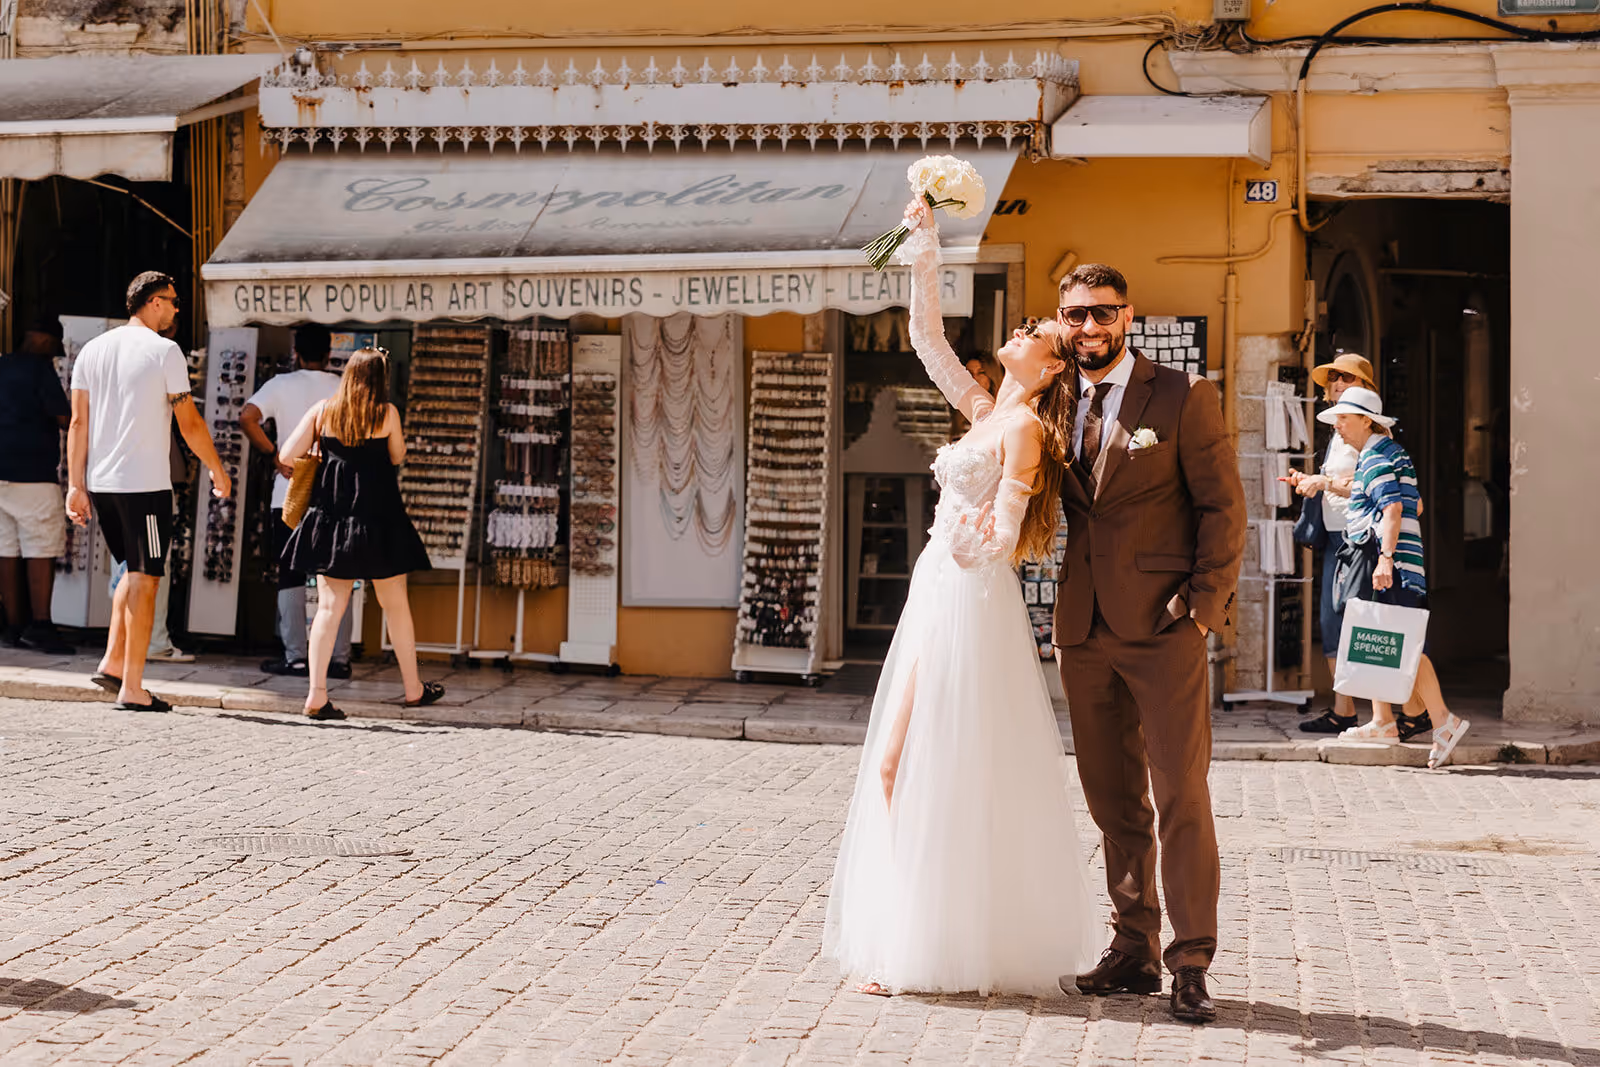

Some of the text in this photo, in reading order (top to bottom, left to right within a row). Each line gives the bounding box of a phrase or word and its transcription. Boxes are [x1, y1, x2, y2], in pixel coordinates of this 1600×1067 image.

[344, 174, 851, 216] Cosmopolitan
[1247, 182, 1274, 200] 48
[234, 284, 312, 313] GREEK
[325, 283, 434, 313] POPULAR
[448, 281, 493, 311] ART
[502, 277, 643, 308] SOUVENIRS
[672, 273, 817, 306] JEWELLERY
[847, 270, 958, 301] LEATR
[1356, 631, 1397, 646] MARKS &
[1353, 641, 1398, 656] SPENCER
